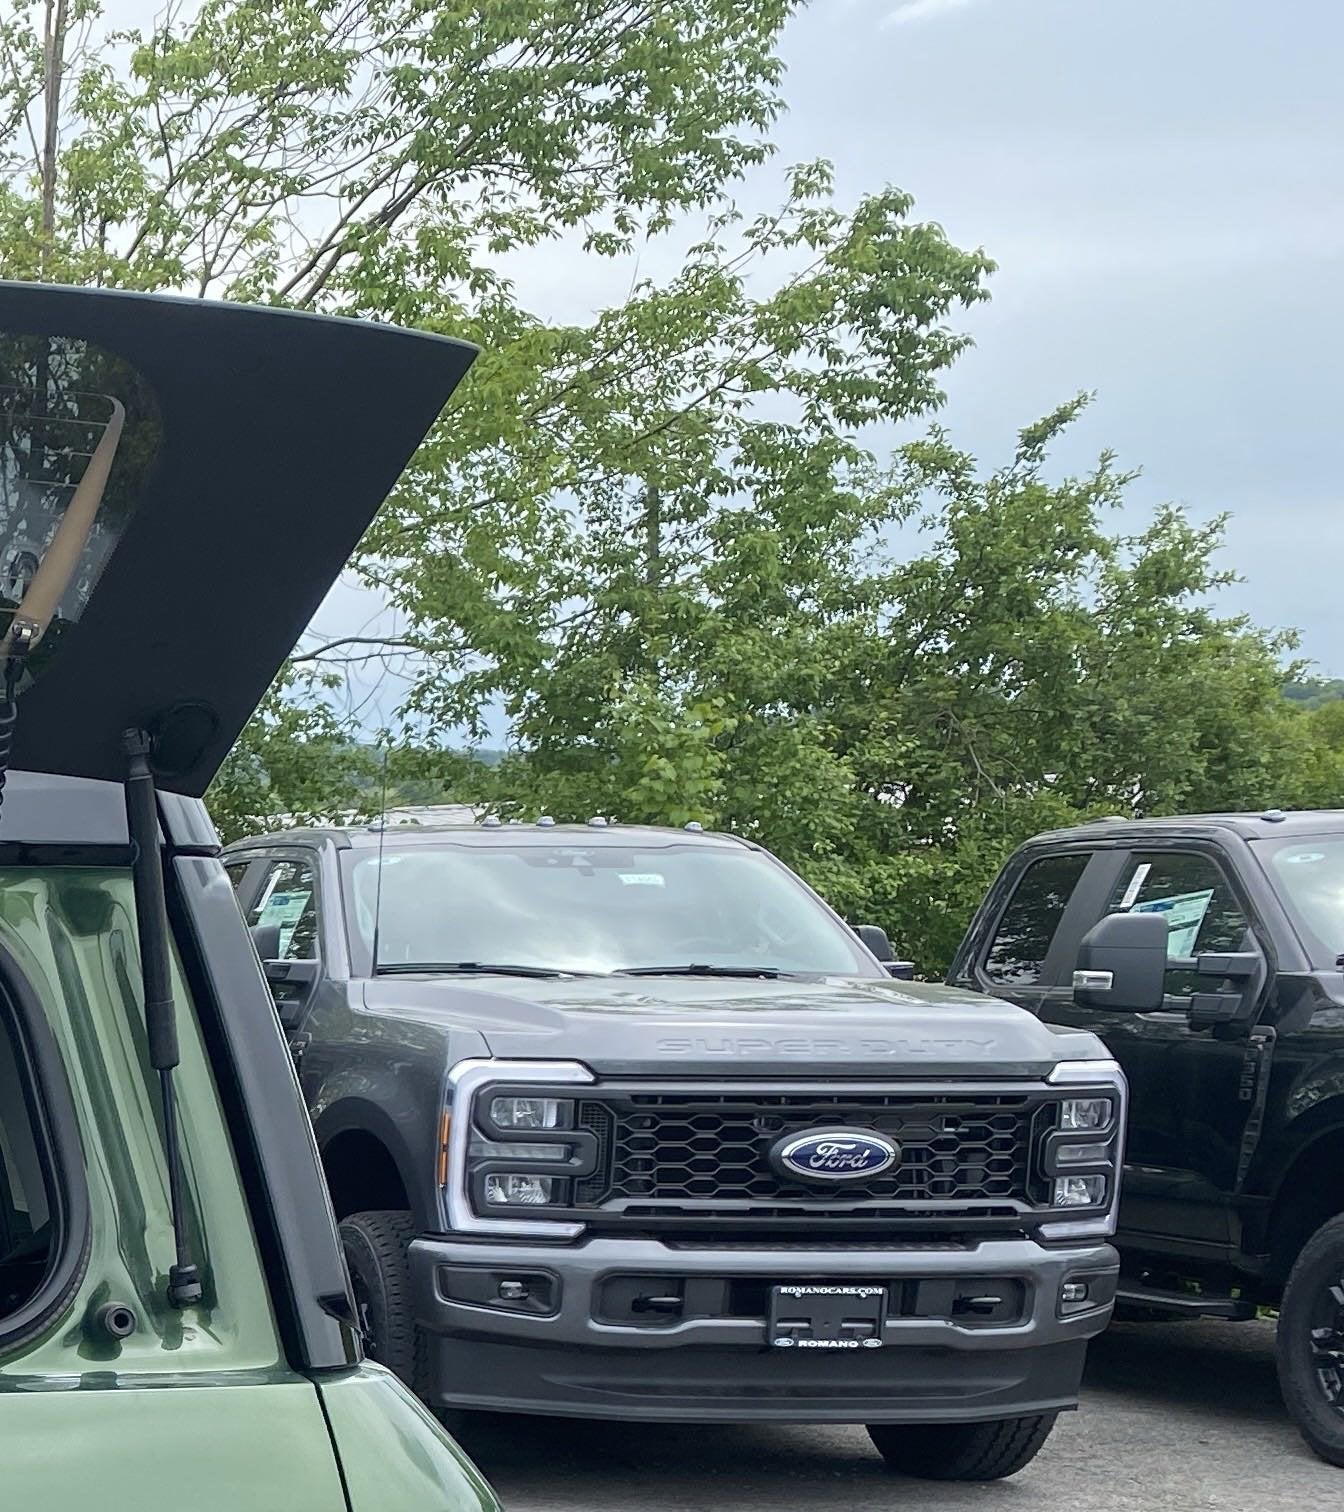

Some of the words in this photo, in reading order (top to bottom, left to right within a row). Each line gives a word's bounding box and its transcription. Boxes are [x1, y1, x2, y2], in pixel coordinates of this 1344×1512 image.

[656, 1037, 850, 1055] SUPER
[860, 1038, 996, 1055] DUTY
[810, 1142, 871, 1168] Ford
[798, 1340, 859, 1348] ROMANO
